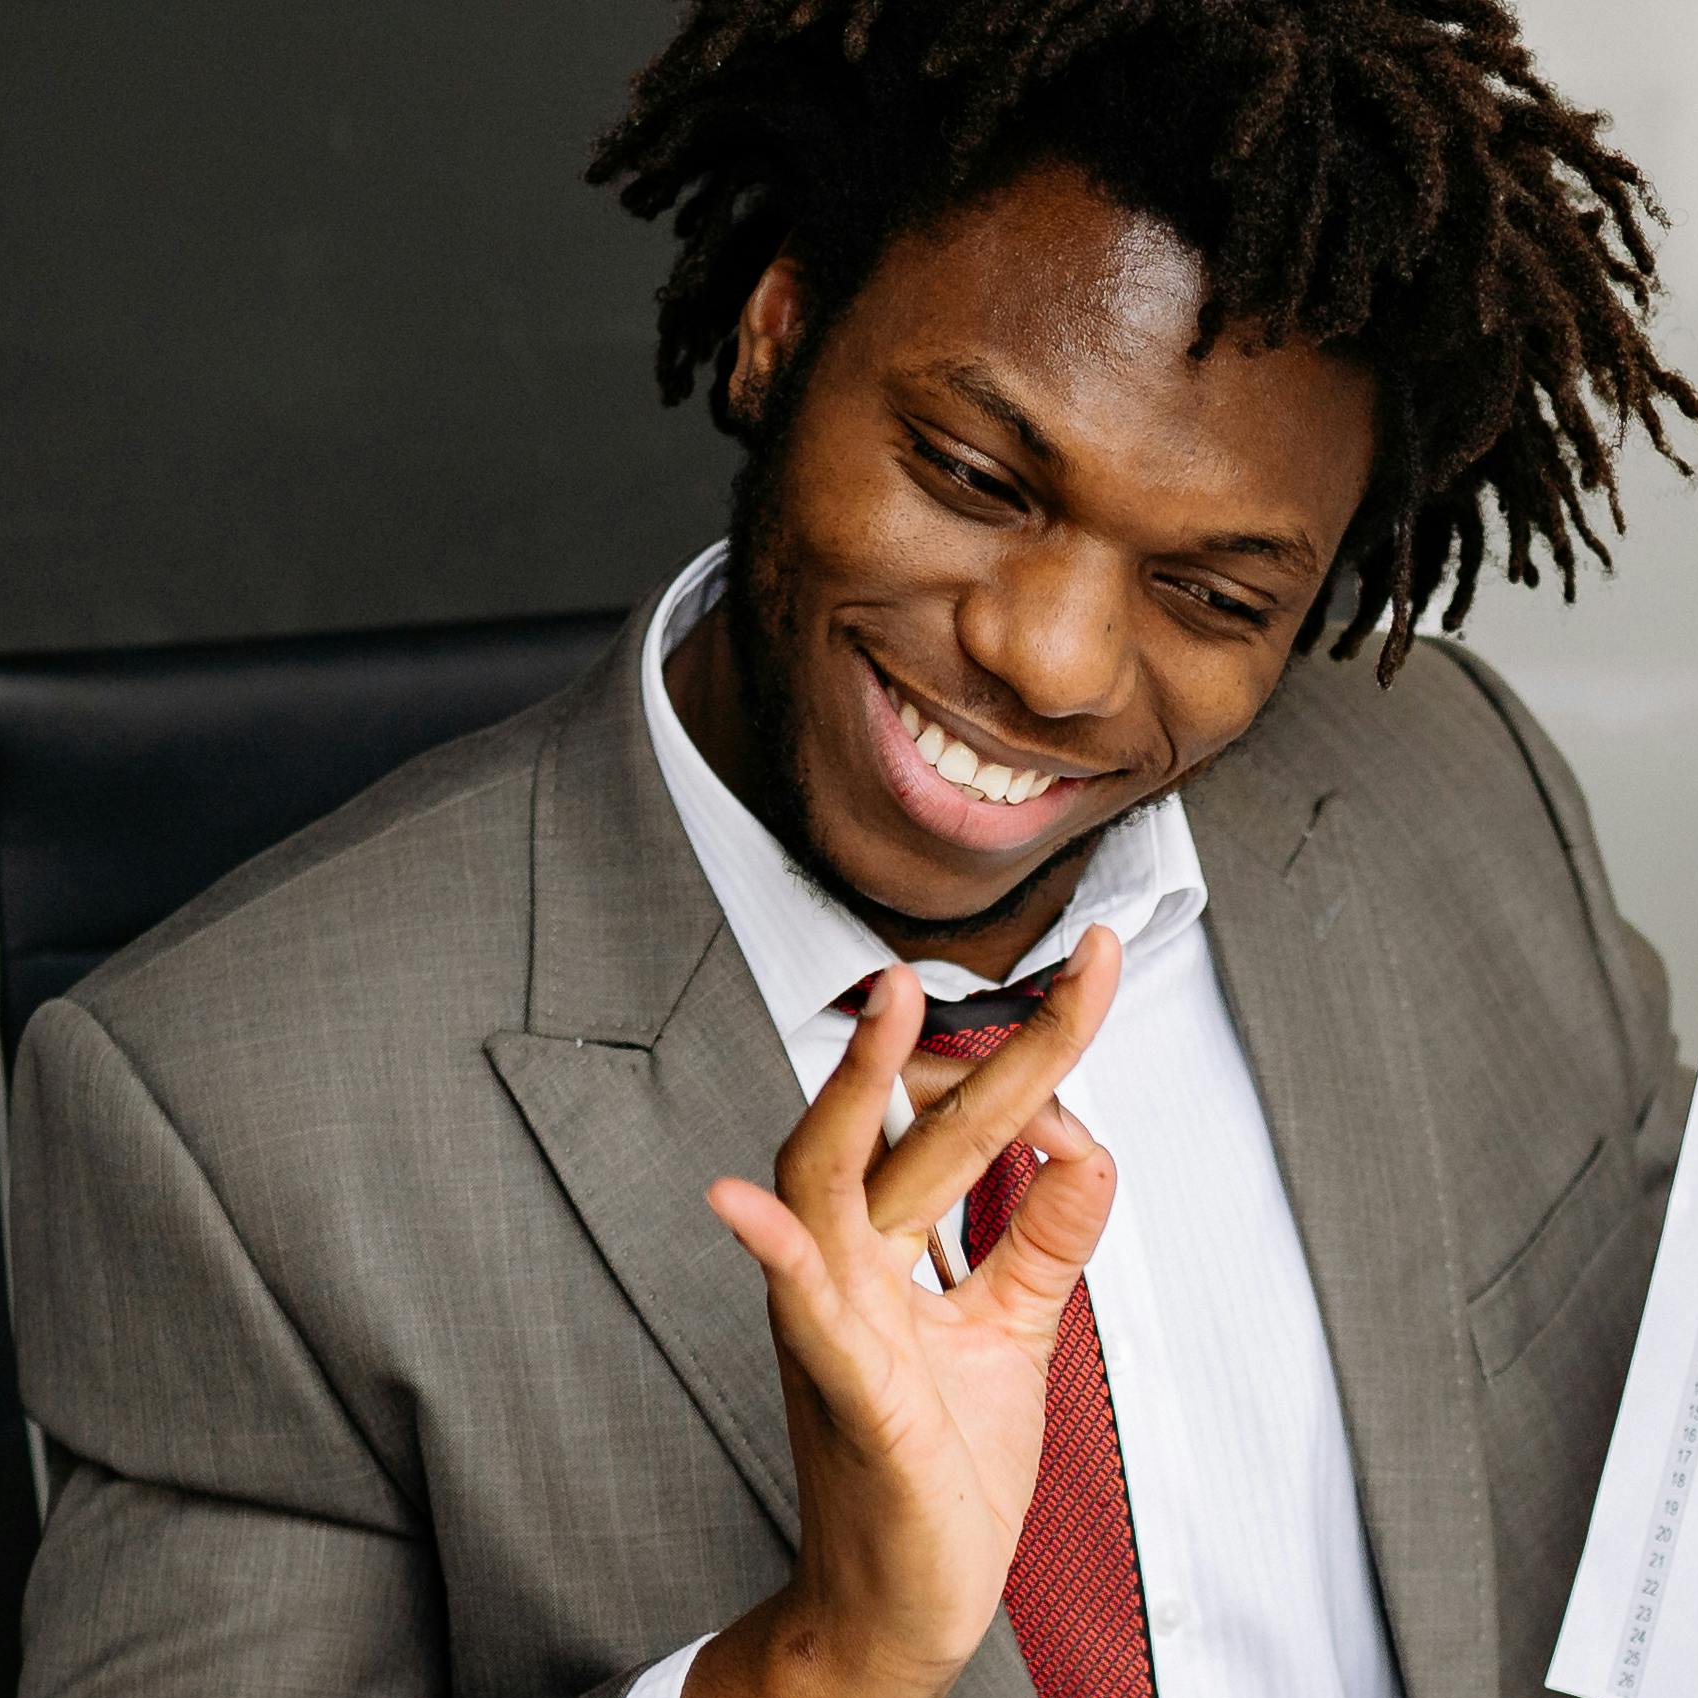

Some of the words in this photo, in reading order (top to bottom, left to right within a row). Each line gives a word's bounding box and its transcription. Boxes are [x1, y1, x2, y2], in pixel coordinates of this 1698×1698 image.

[1683, 1427, 1697, 1442] 16
[1678, 1450, 1692, 1464] 17
[1672, 1472, 1686, 1488] 18
[1665, 1500, 1678, 1515] 19
[1656, 1526, 1671, 1543] 20
[1649, 1553, 1664, 1568] 21
[1643, 1579, 1659, 1596] 22
[1636, 1606, 1652, 1622] 23
[1630, 1631, 1646, 1644] 24
[1624, 1650, 1640, 1666] 25
[1618, 1672, 1634, 1687] 26
